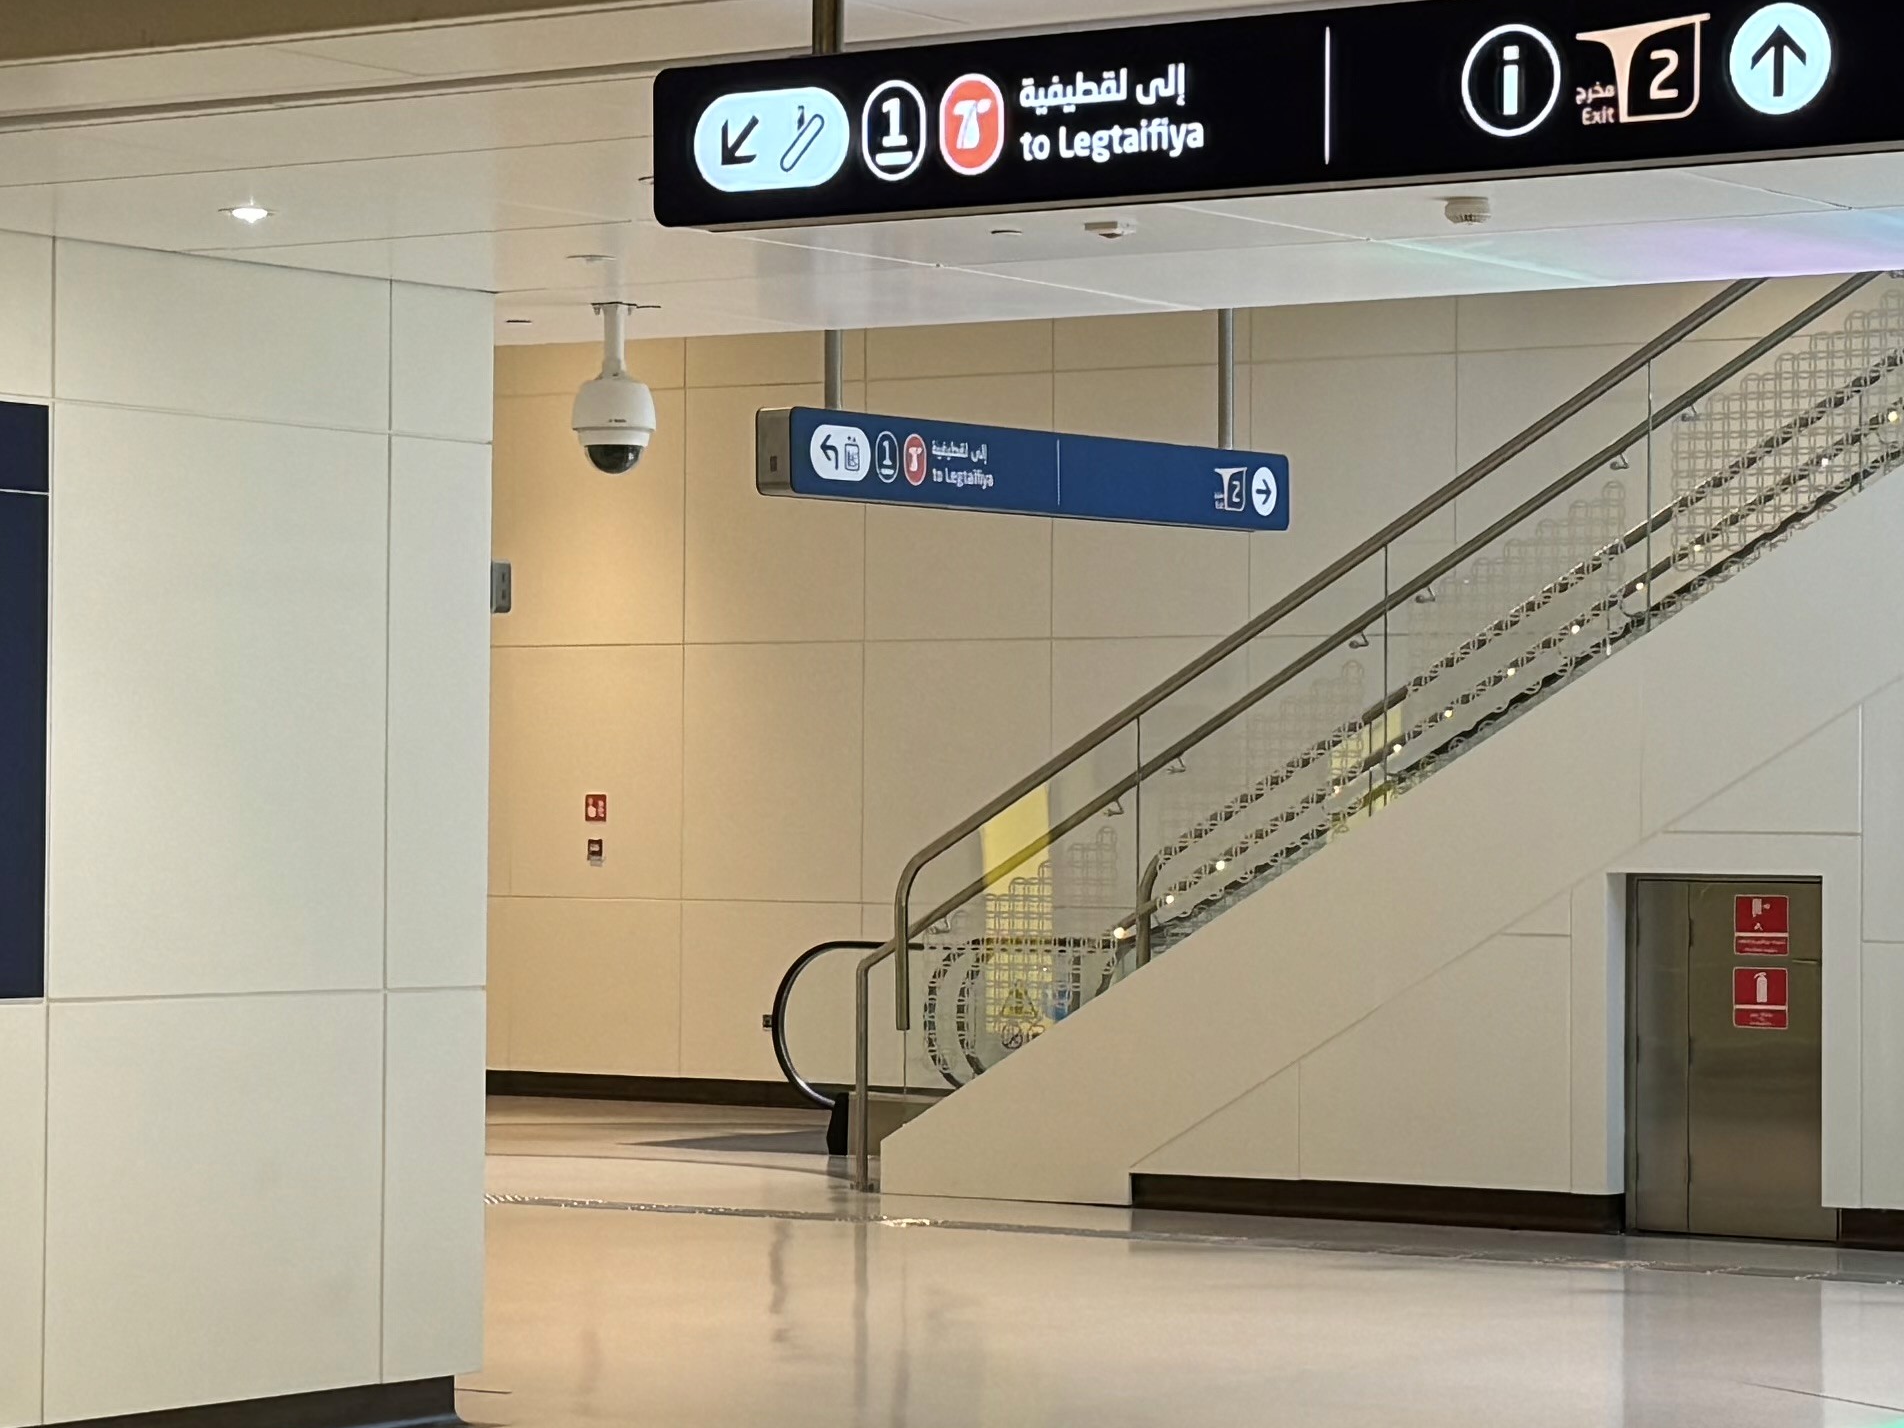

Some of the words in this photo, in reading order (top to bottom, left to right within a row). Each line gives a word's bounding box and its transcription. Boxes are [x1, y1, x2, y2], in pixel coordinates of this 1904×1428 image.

[1020, 68, 1127, 115] لقطيفية
[1136, 63, 1185, 106] إلى
[1576, 82, 1615, 104] مخرج
[1650, 49, 1678, 99] 2
[1582, 106, 1614, 125] Exit
[1020, 132, 1050, 161] to
[1059, 117, 1204, 163] Legtaifiya
[933, 468, 943, 482] to
[945, 468, 993, 489] Legtaifiya
